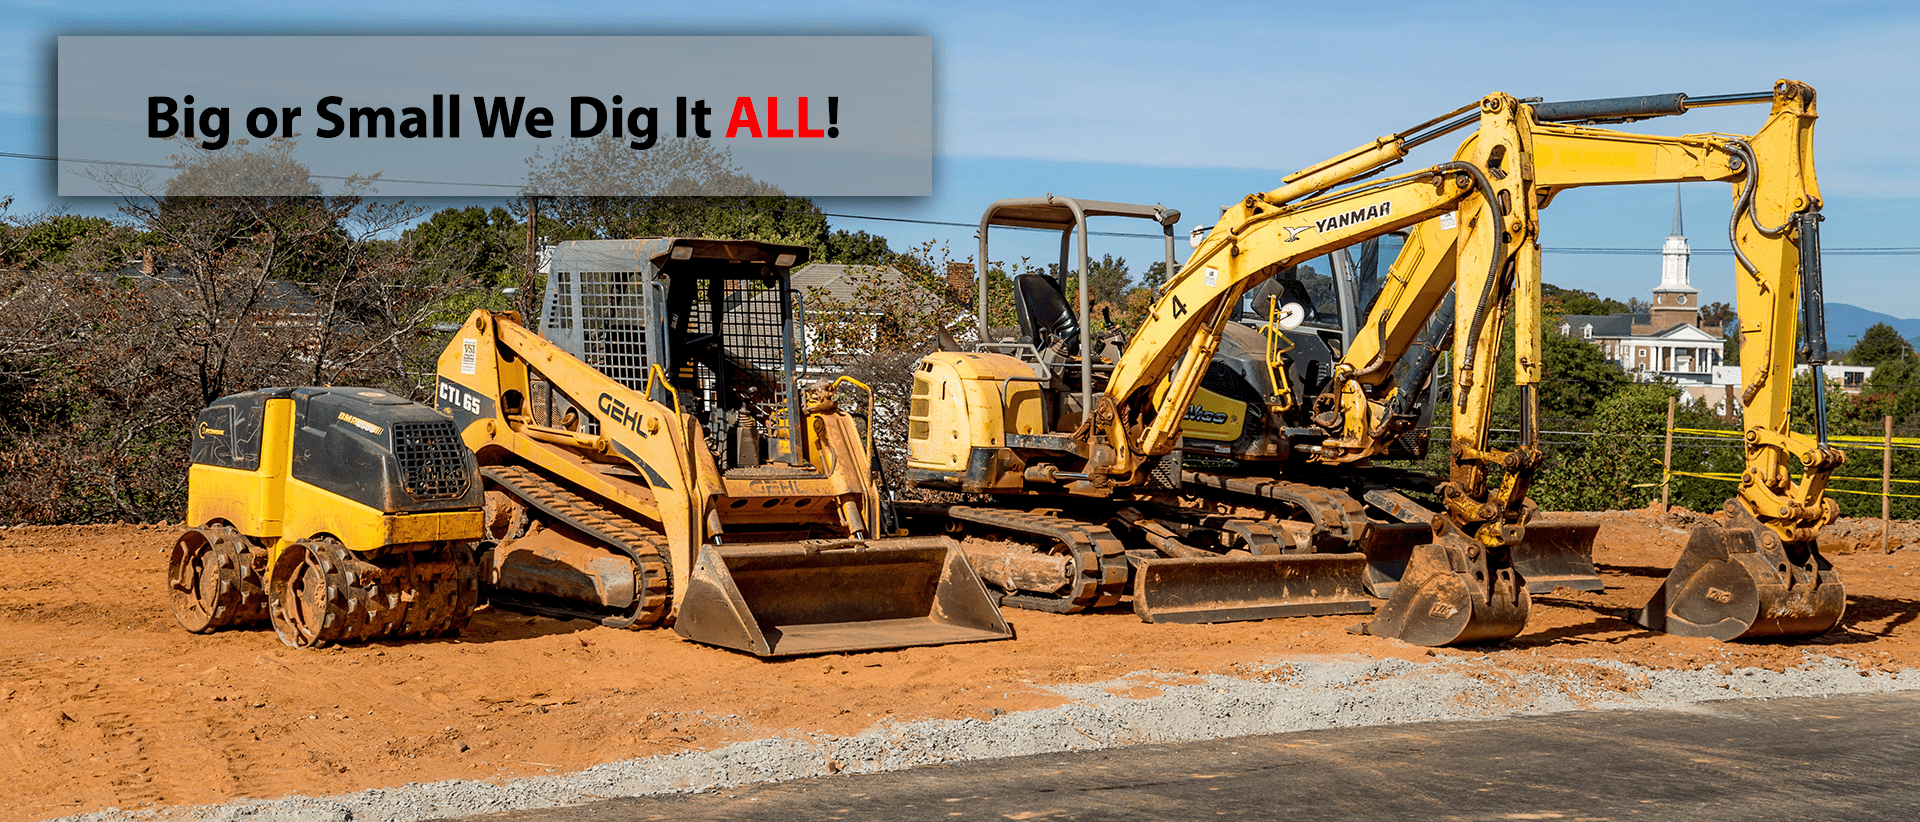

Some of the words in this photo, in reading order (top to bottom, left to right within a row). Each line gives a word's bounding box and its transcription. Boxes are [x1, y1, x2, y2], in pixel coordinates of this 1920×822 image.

[1315, 201, 1391, 233] YANMAR
[1172, 294, 1188, 320] 4
[464, 343, 476, 354] VSI
[439, 381, 462, 407] CTL
[462, 392, 481, 416] 65
[597, 392, 648, 439] GEHL
